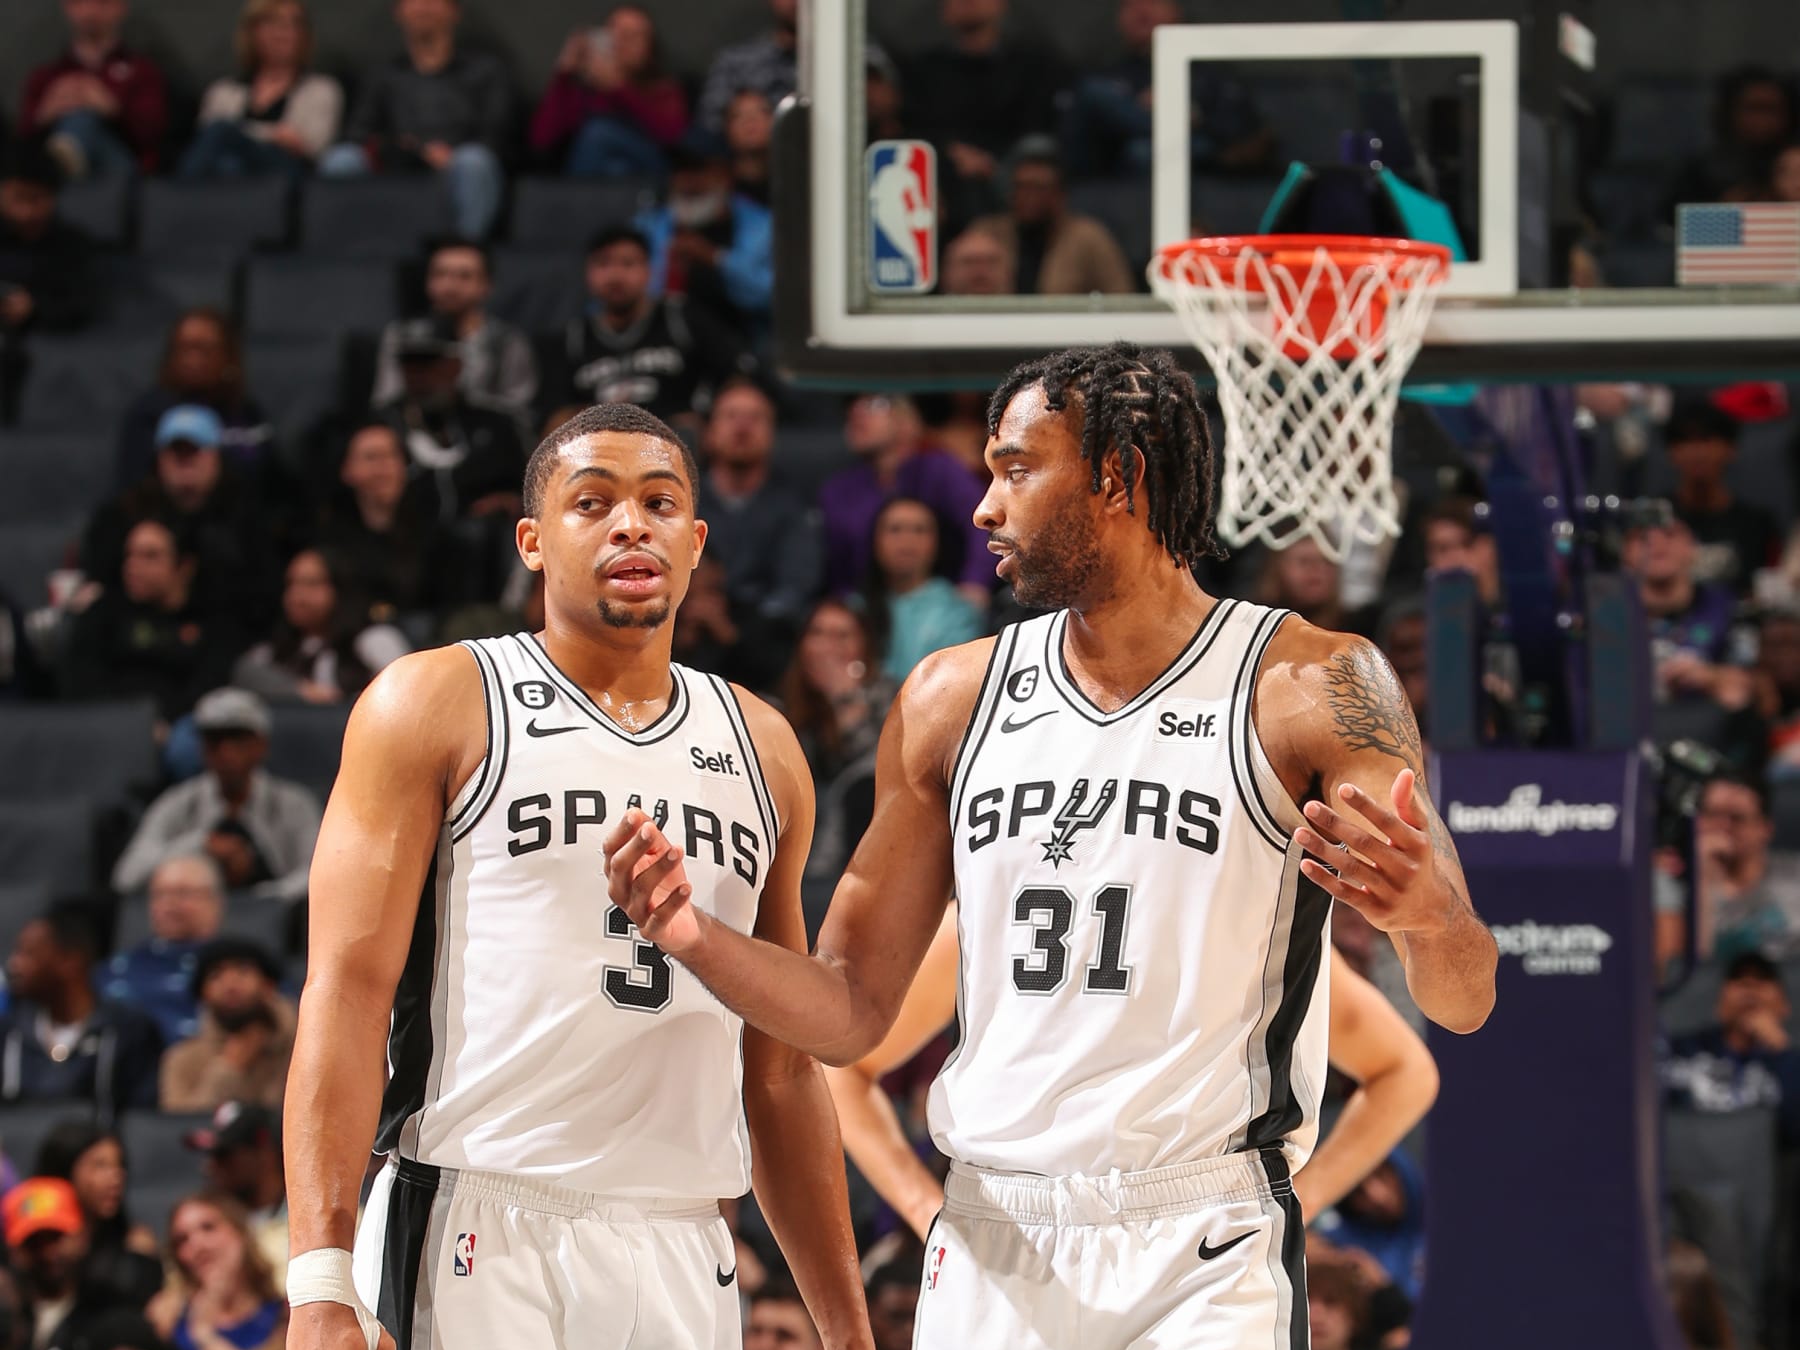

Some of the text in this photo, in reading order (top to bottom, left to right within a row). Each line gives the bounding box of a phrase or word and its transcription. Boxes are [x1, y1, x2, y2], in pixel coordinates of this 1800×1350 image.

[520, 684, 546, 706] 6
[1013, 666, 1037, 698] 6
[1158, 711, 1216, 738] Self.
[690, 746, 741, 777] Self.
[968, 778, 1222, 870] SPURS
[1011, 883, 1134, 997] 31
[601, 903, 674, 1015] 3
